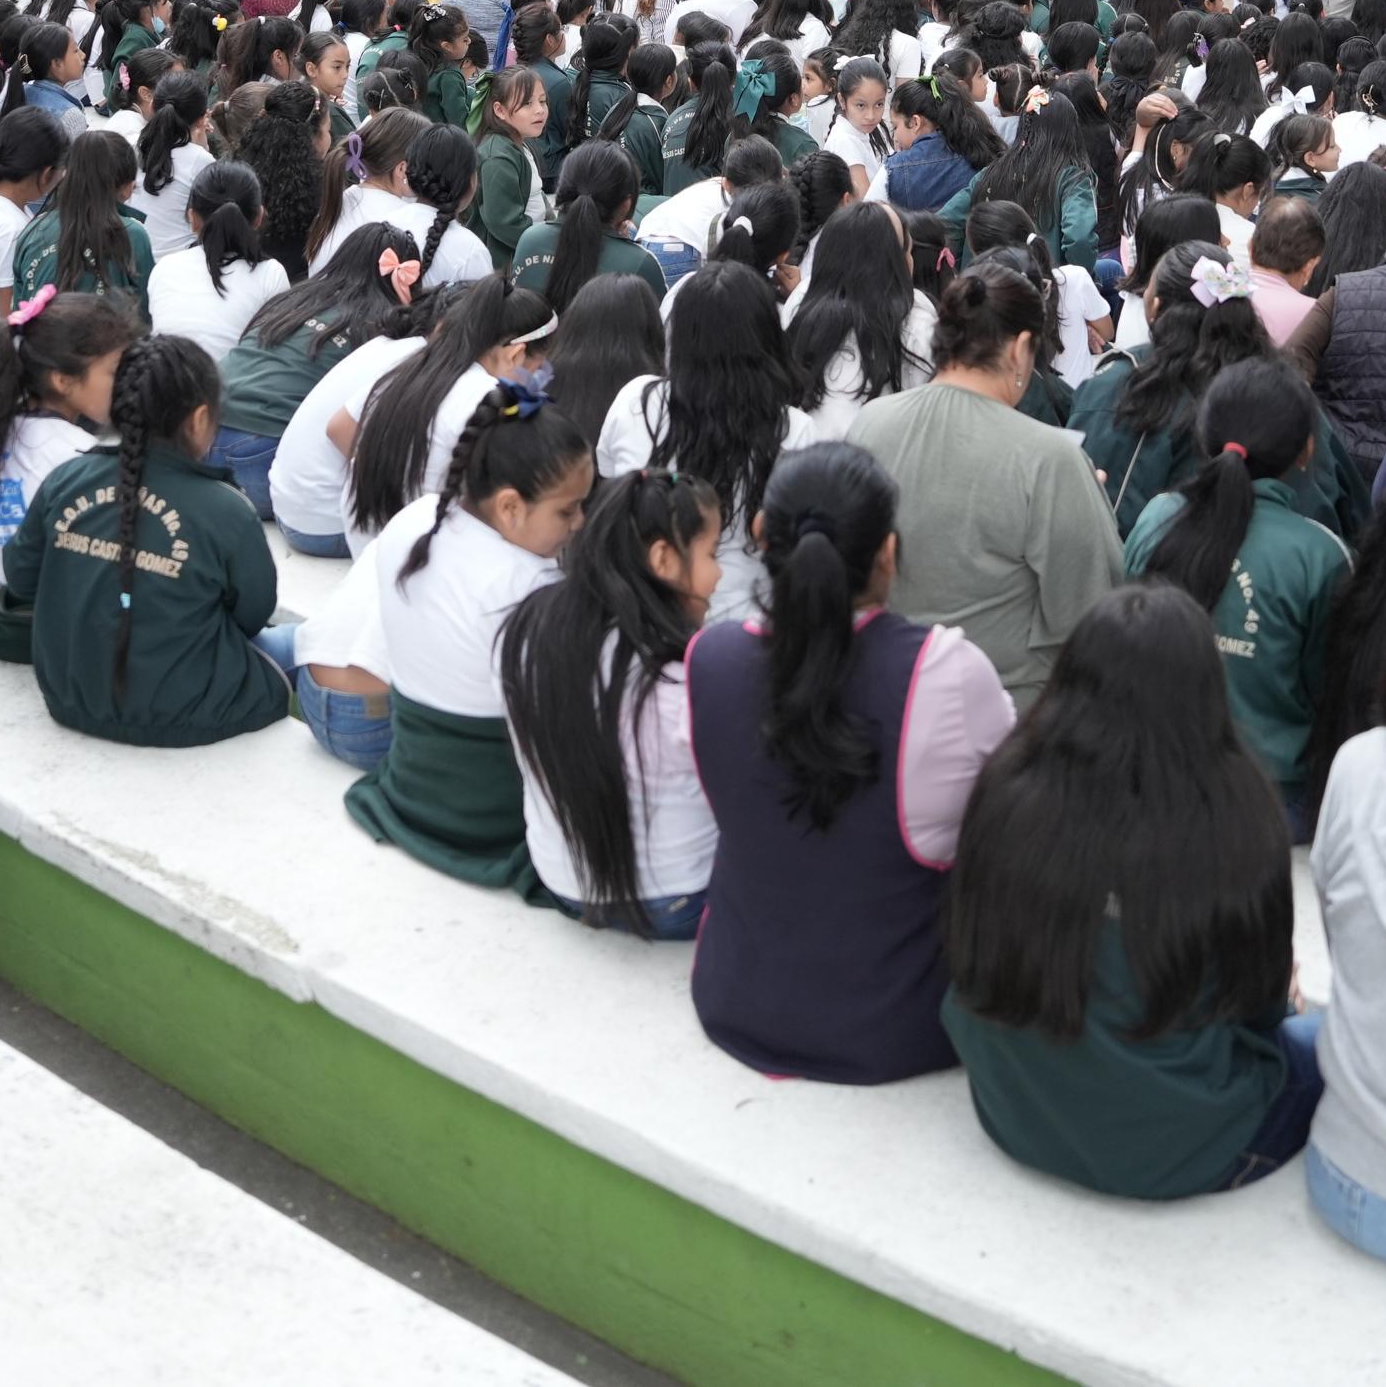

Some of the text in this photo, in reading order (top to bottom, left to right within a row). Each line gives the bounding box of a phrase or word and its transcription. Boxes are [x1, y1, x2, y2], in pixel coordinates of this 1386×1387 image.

[95, 486, 115, 504] DE
[171, 539, 189, 561] 49
[54, 532, 90, 554] JESUS
[135, 550, 183, 579] GOMEZ
